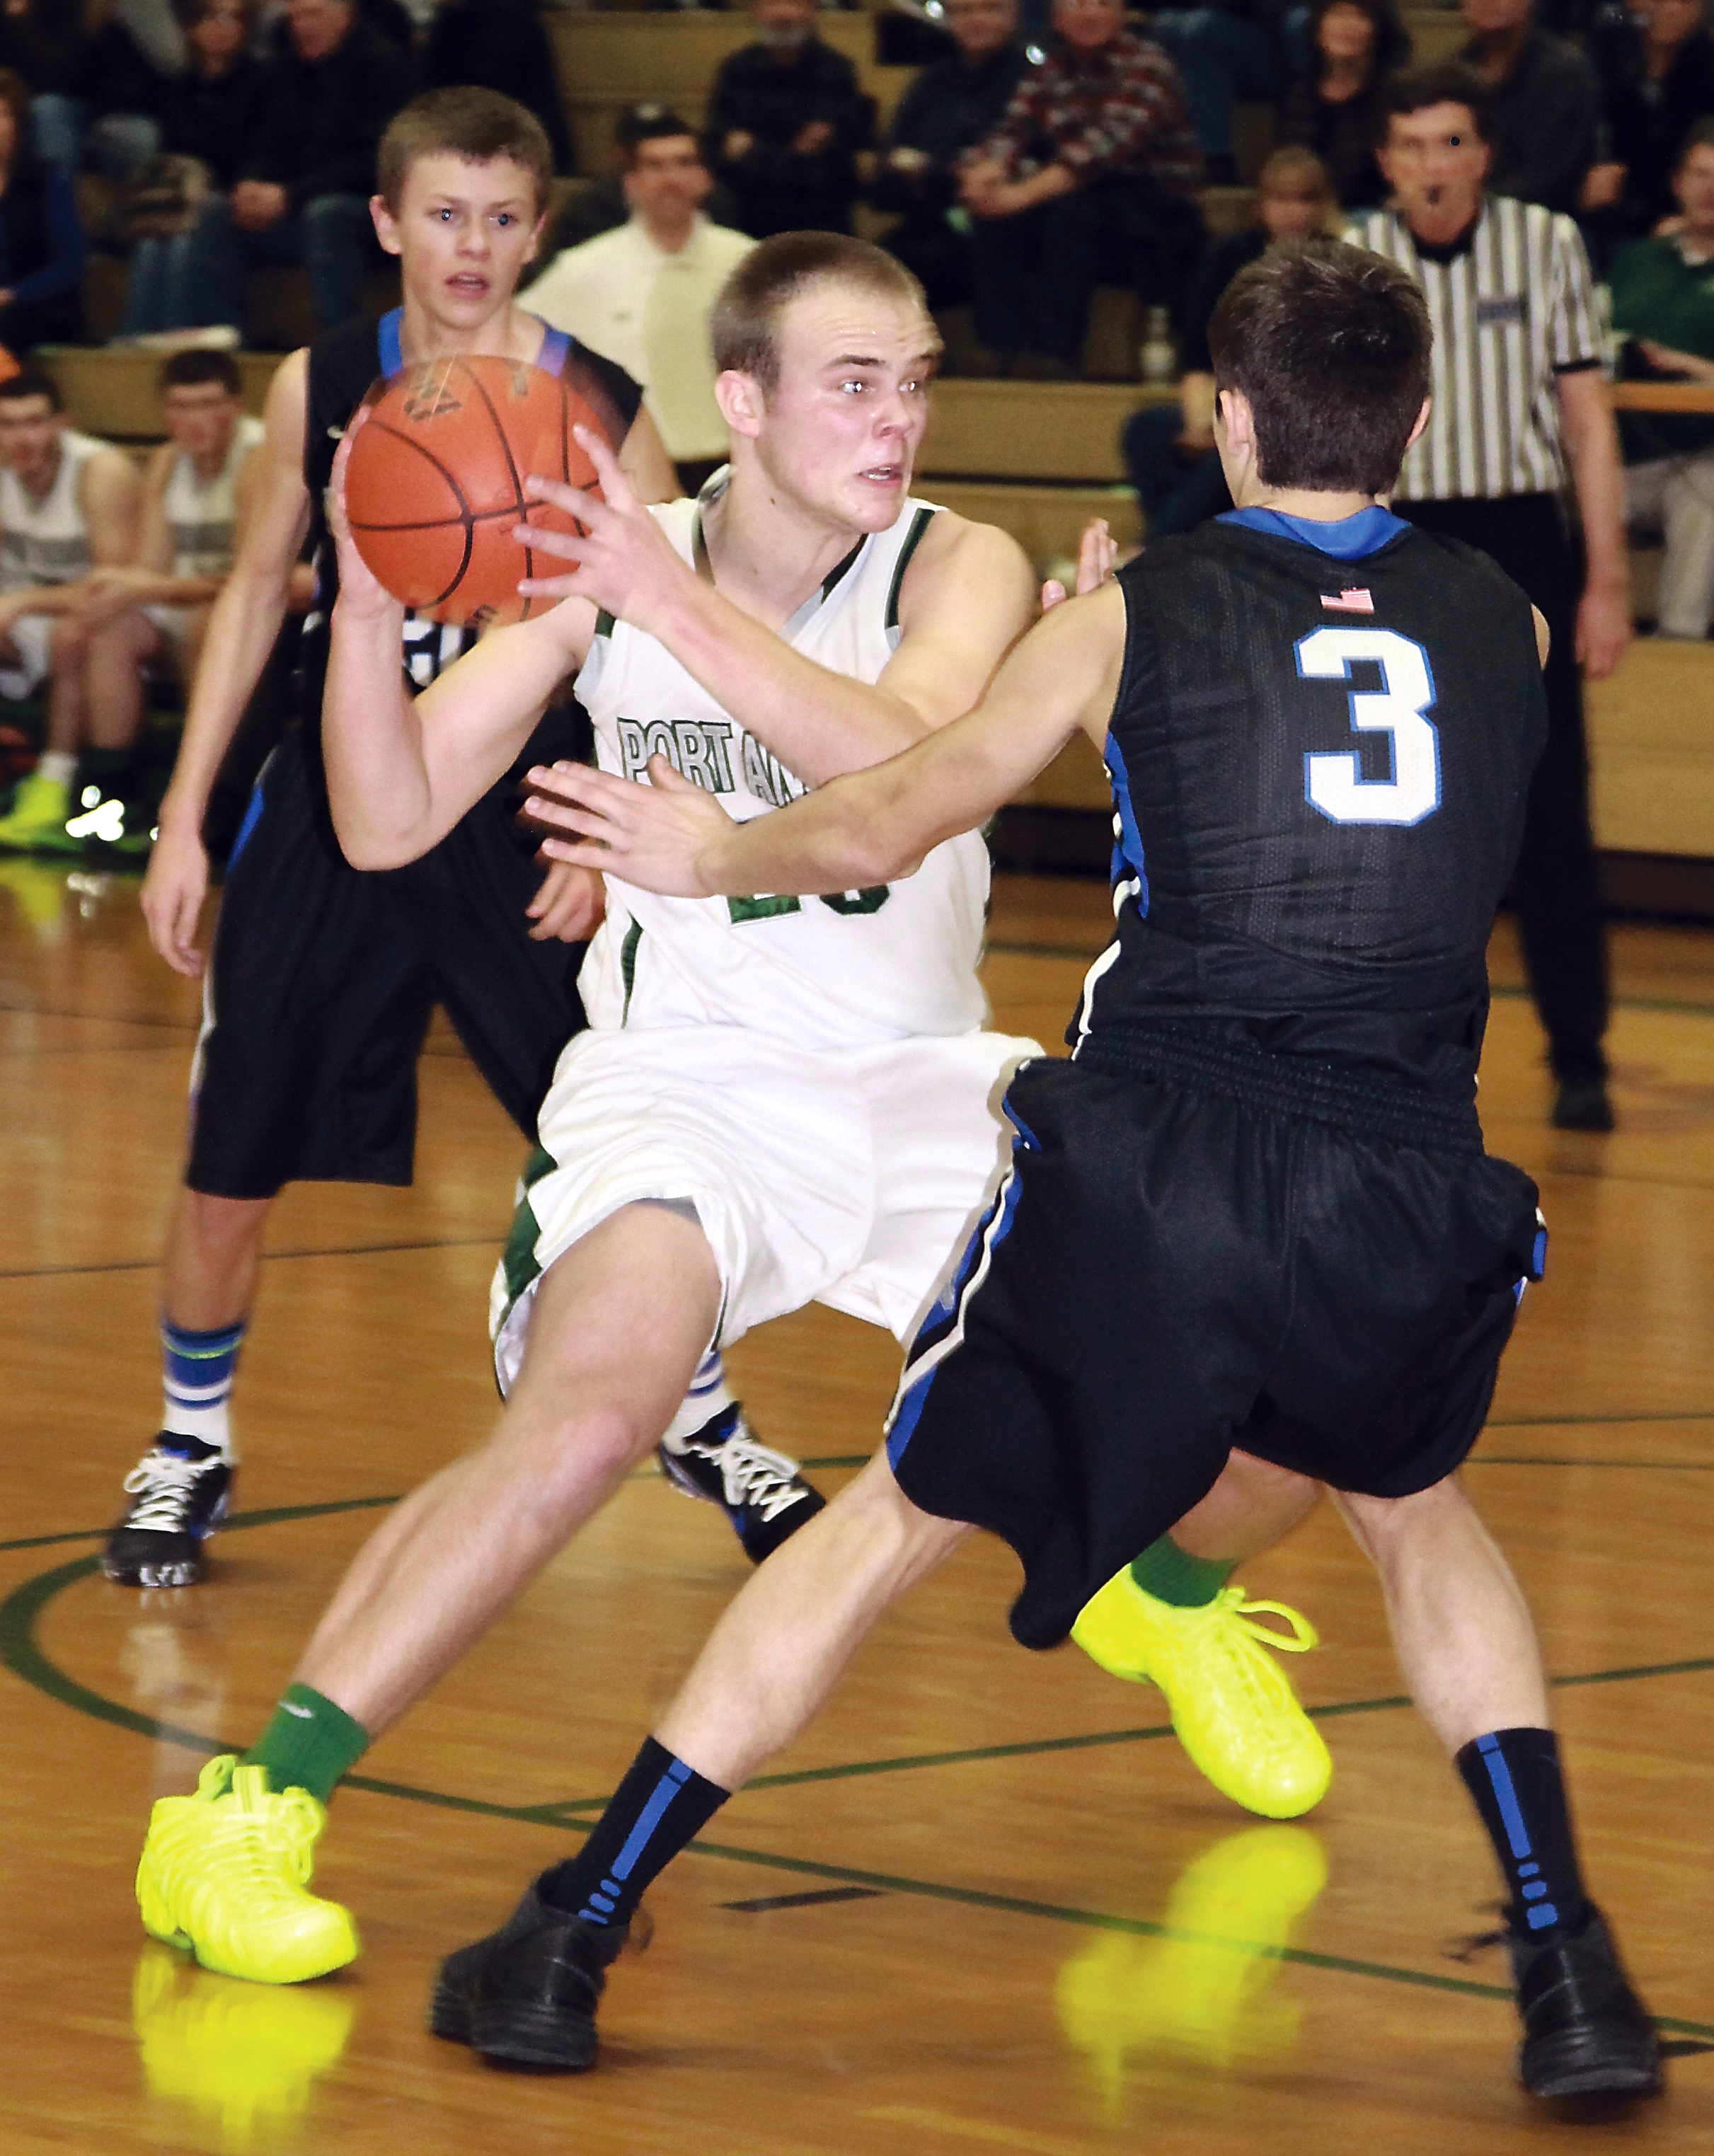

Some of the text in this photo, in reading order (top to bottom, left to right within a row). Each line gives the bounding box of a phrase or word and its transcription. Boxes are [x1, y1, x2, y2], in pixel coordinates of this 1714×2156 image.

[617, 717, 806, 809] PORT AN
[1293, 625, 1442, 826] 3
